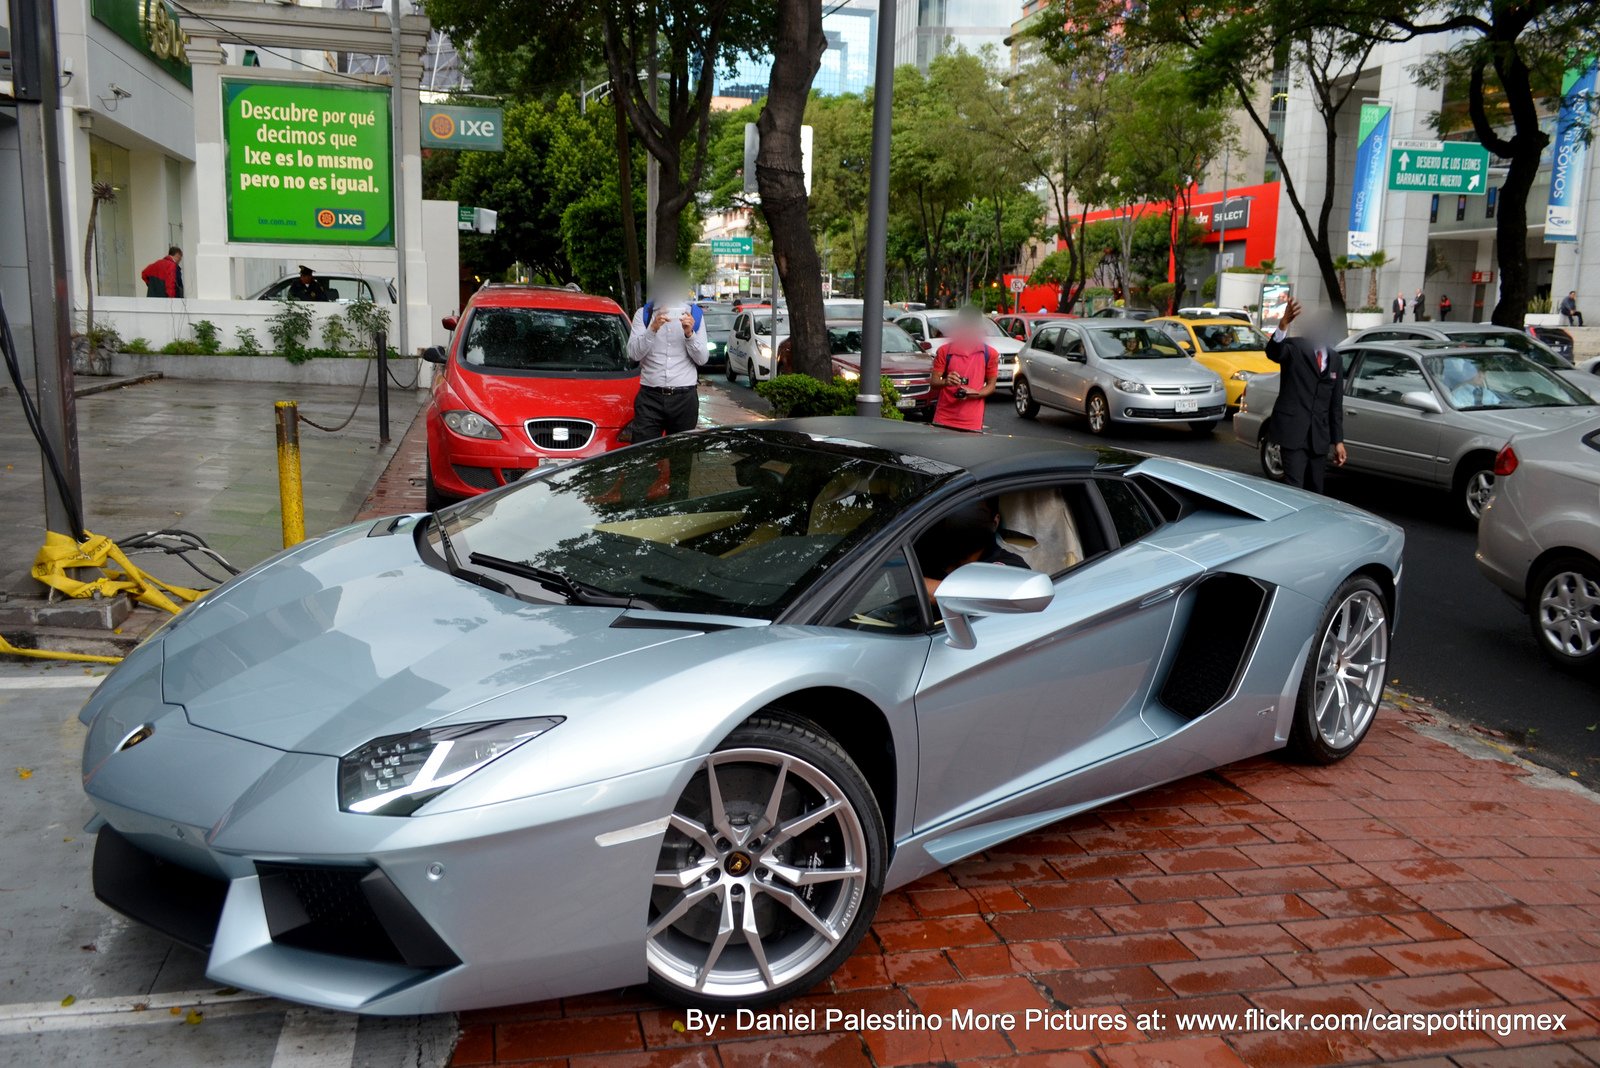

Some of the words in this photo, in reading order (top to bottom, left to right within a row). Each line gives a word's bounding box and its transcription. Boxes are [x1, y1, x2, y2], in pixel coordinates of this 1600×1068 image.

[240, 99, 318, 123] Descubre
[322, 107, 346, 127] por
[349, 109, 375, 127] qué
[256, 124, 326, 146] decimos
[329, 132, 357, 150] que
[244, 146, 271, 166] Ixe
[275, 151, 294, 168] es
[297, 149, 314, 169] lo
[317, 153, 374, 171] mismo
[1416, 155, 1441, 169] DESIERTO
[1441, 157, 1450, 169] DE
[1450, 158, 1460, 170] LOS
[1461, 158, 1481, 171] LEONES
[240, 172, 280, 191] pero
[283, 175, 305, 190] no
[309, 176, 327, 191] es
[331, 173, 380, 196] igual.
[1396, 172, 1427, 186] BARRANCA
[1427, 173, 1438, 187] DEL
[1440, 174, 1462, 187] MUERTO
[1553, 144, 1570, 199] SOMOS
